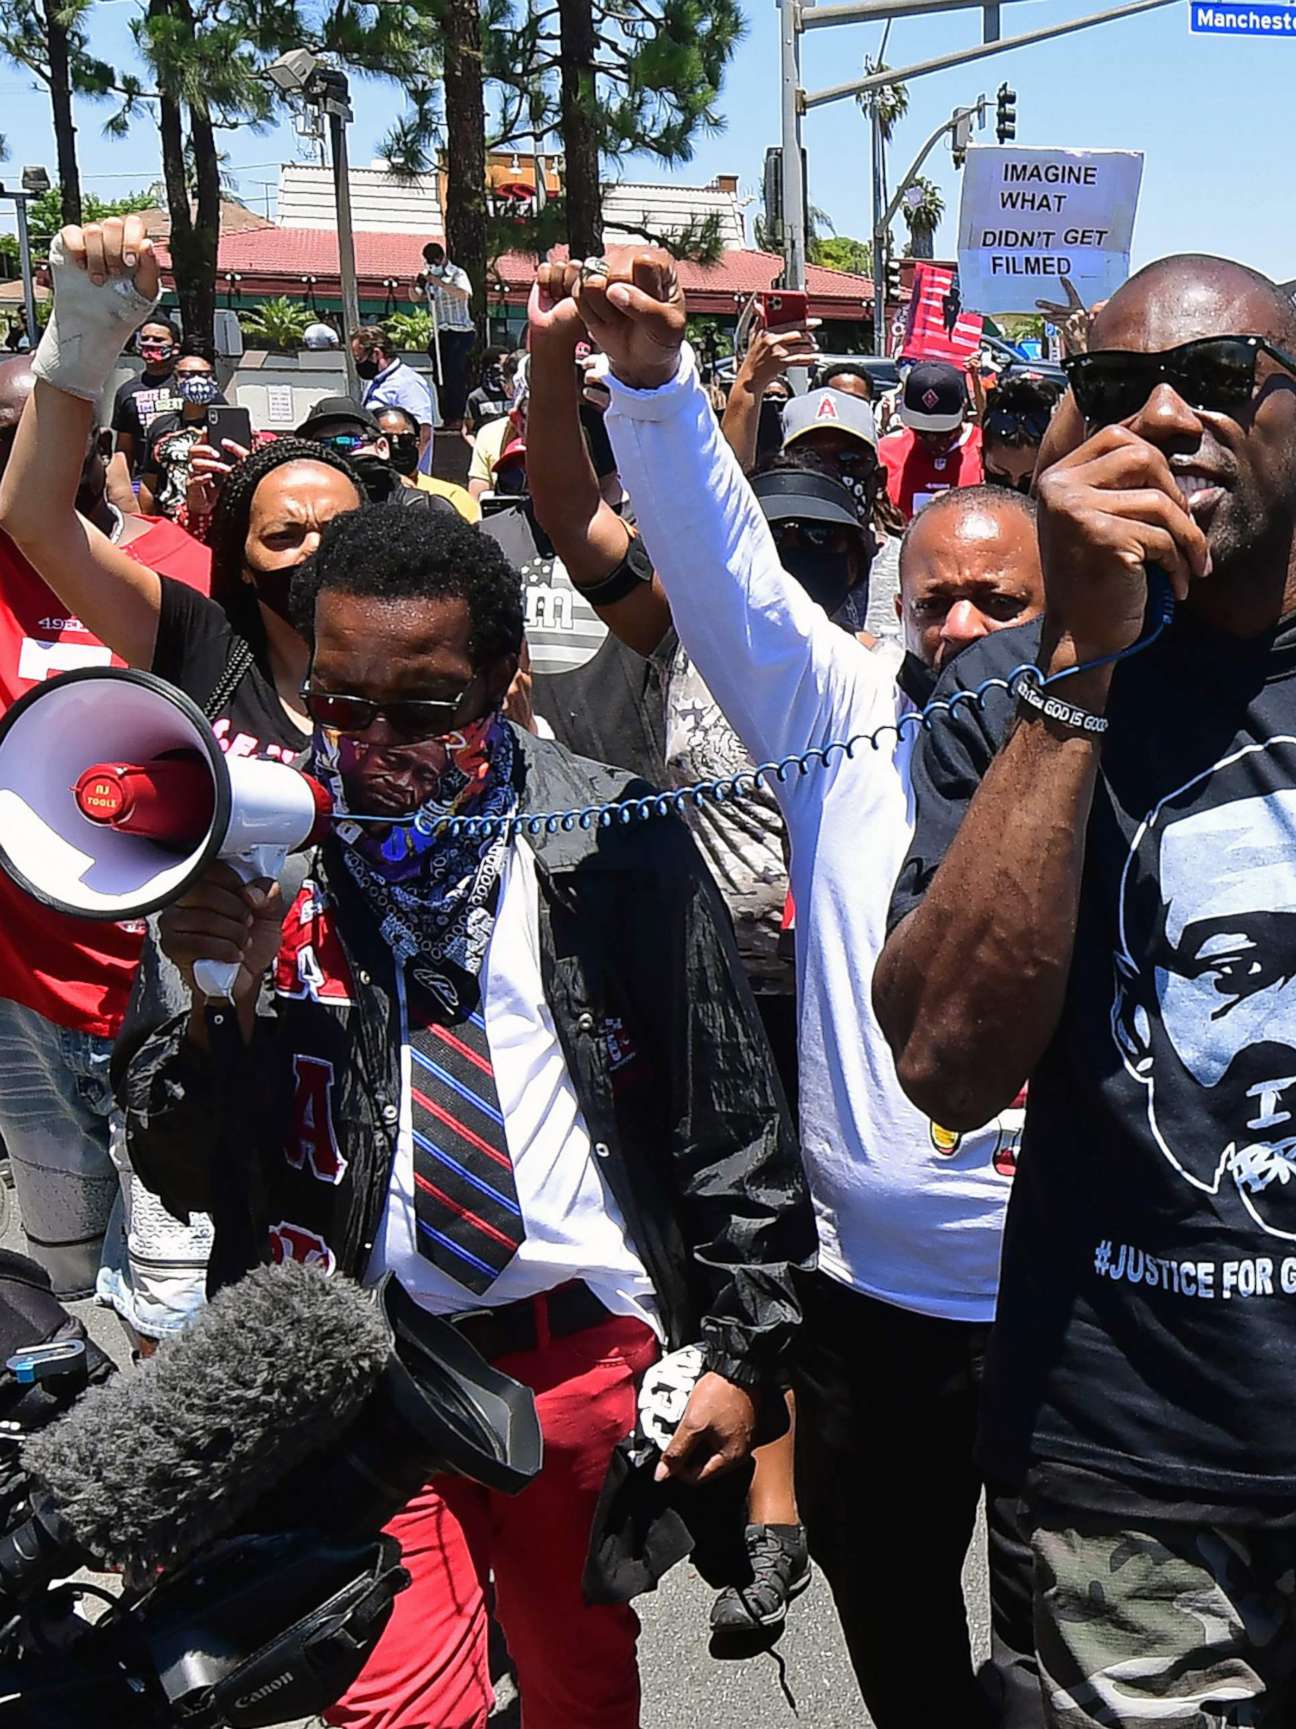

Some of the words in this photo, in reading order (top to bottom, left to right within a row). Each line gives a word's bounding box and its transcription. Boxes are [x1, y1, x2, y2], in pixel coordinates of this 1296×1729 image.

[1003, 163, 1097, 185] IMAGINE
[1000, 192, 1067, 212] WHAT
[982, 230, 1056, 248] DIDN'T
[1063, 229, 1108, 246] GET
[992, 256, 1071, 275] FILMED
[1044, 700, 1070, 721] GOD
[1069, 710, 1084, 726] IS
[1094, 1239, 1215, 1299] #JUSTICE
[1222, 1257, 1275, 1299] FOR
[234, 1671, 294, 1709] Canon
